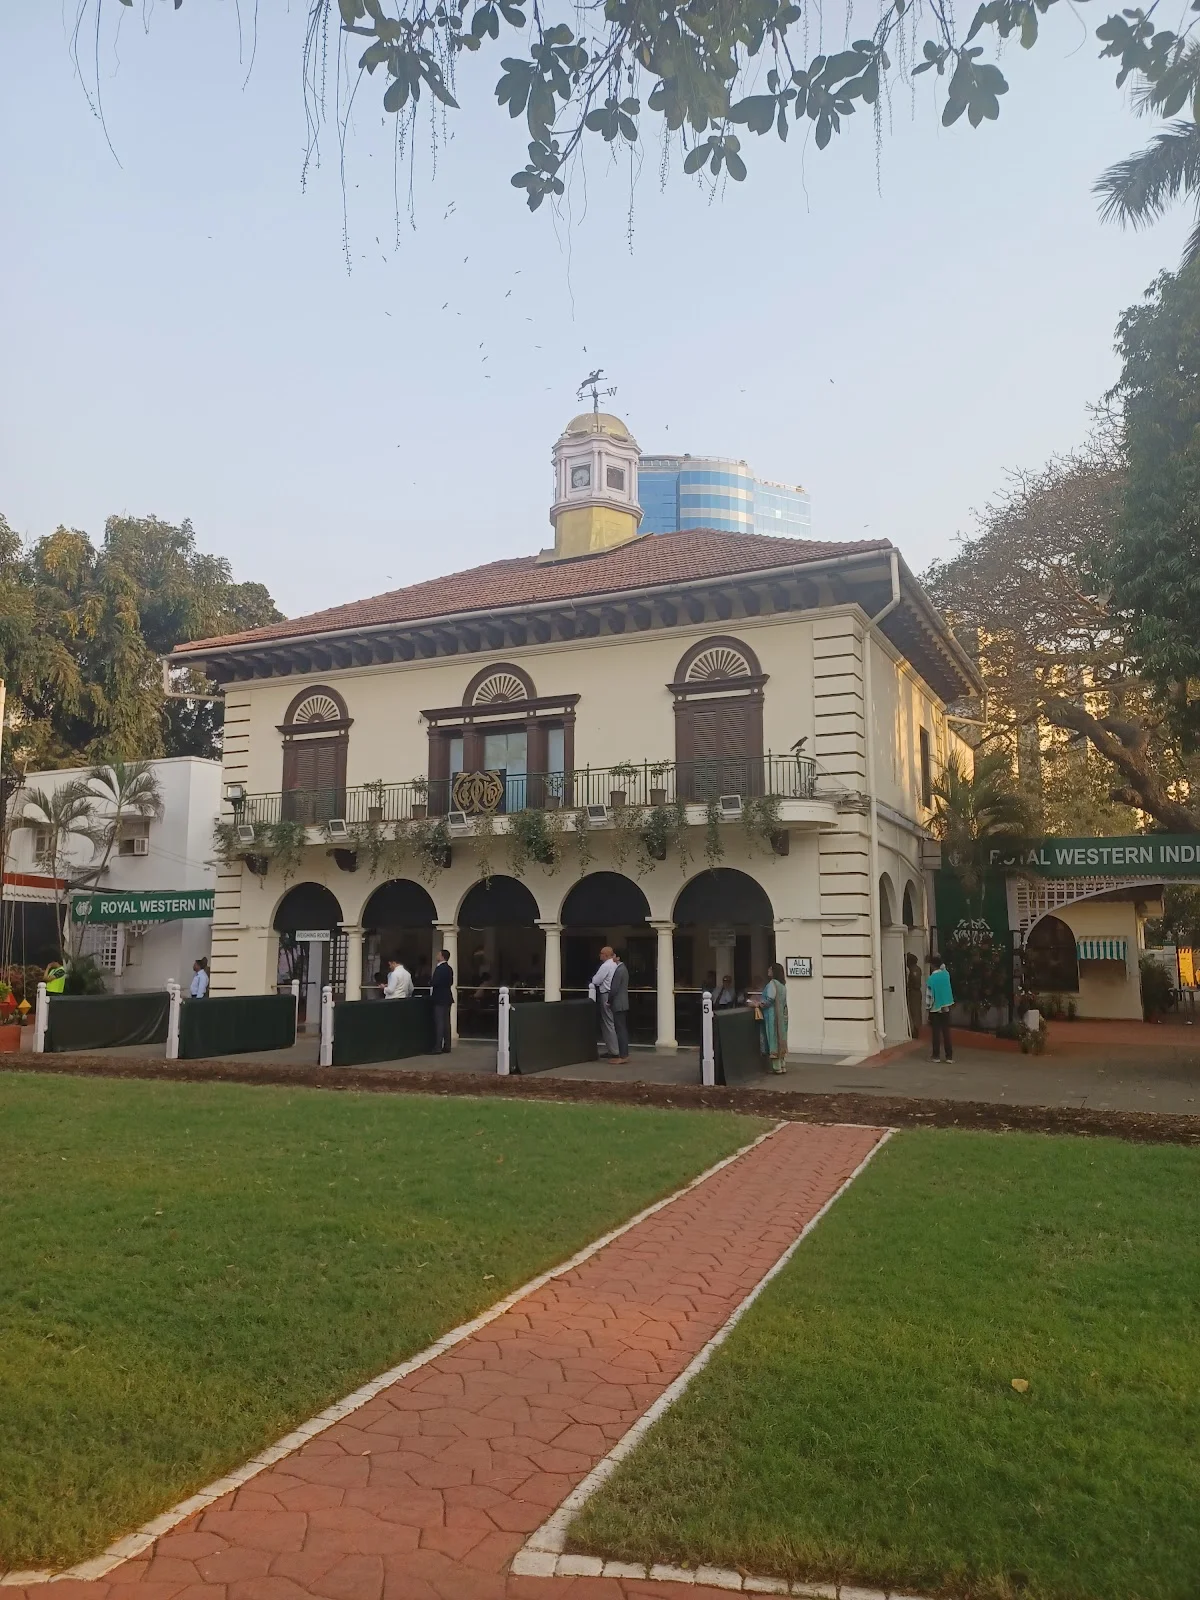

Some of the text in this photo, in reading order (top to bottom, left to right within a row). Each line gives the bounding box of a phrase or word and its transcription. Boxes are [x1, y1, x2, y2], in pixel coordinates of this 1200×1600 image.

[606, 386, 617, 397] W
[989, 848, 1051, 865] RAL
[1055, 846, 1153, 865] WESTERN
[100, 901, 138, 914] ROYAL
[139, 898, 196, 913] WESTERN
[793, 959, 806, 967] ALL
[789, 967, 811, 975] WEIGH
[171, 992, 176, 1001] 2
[323, 995, 328, 1004] 3
[499, 996, 505, 1006] 4
[703, 1003, 710, 1014] 5
